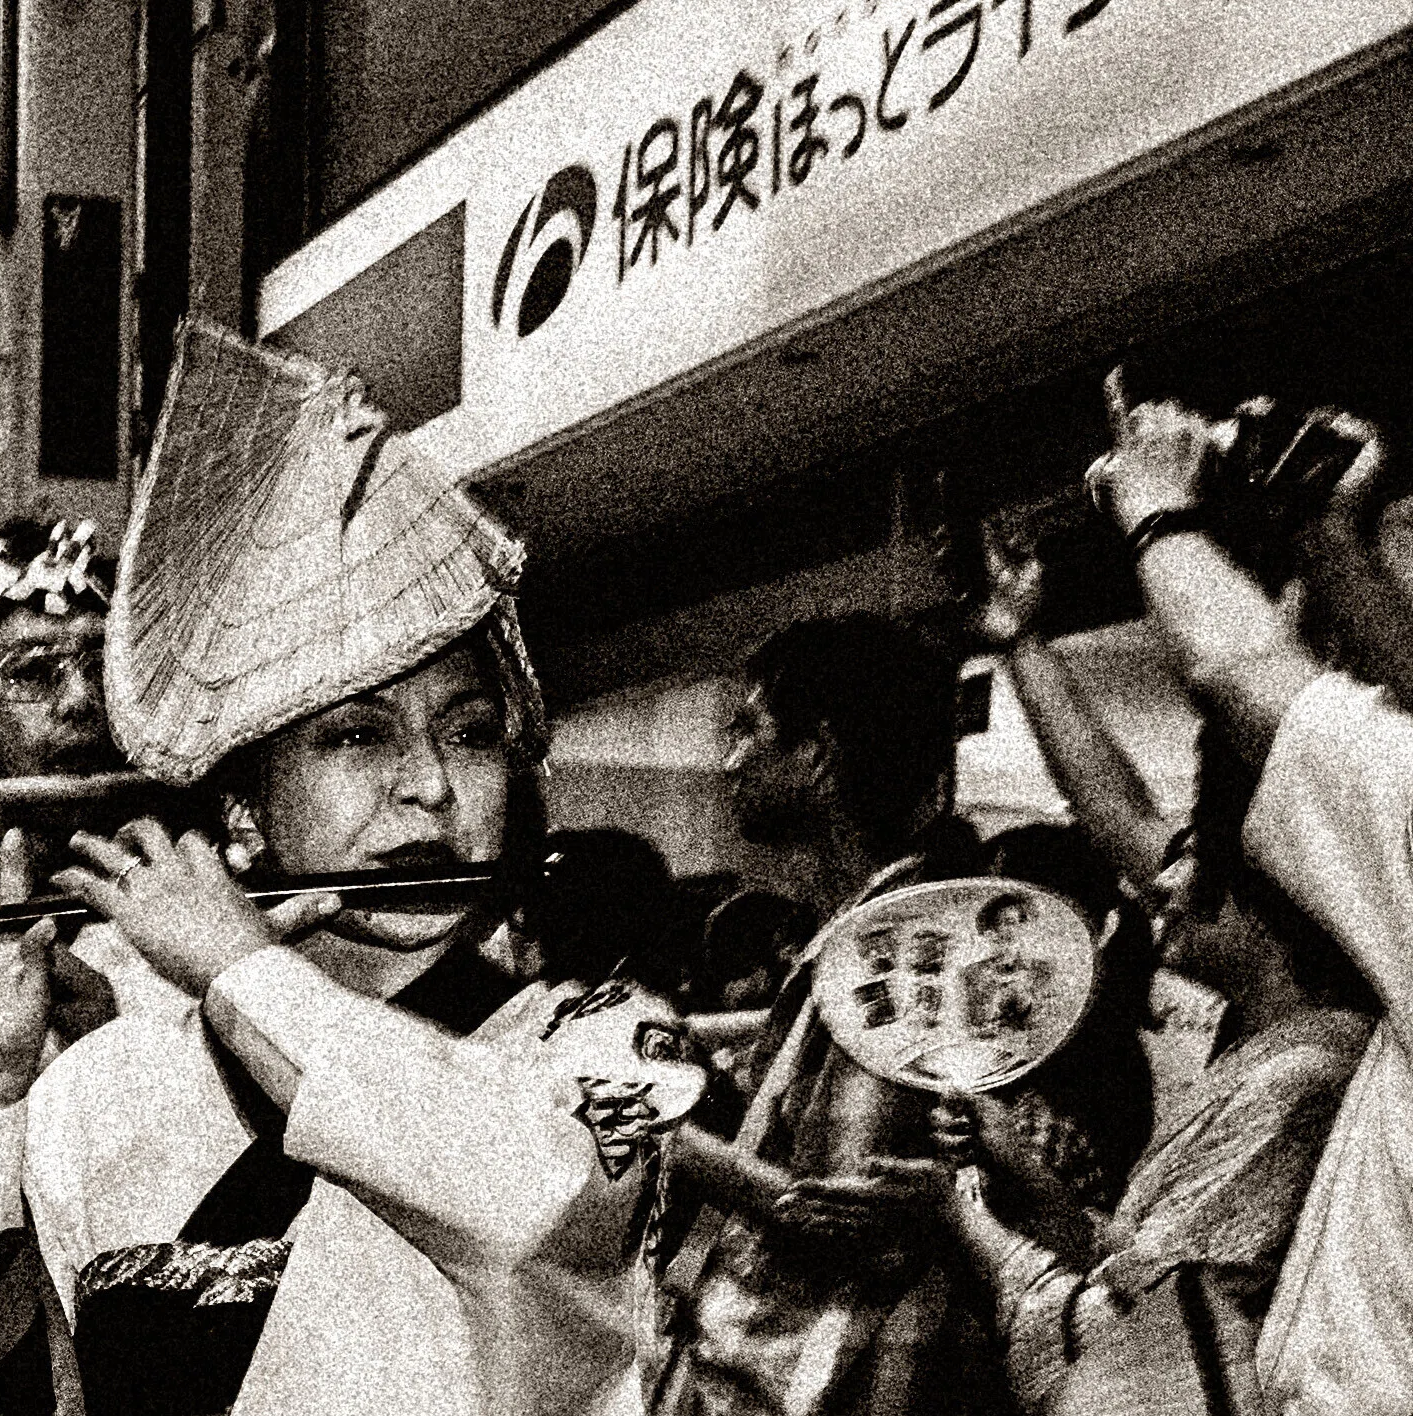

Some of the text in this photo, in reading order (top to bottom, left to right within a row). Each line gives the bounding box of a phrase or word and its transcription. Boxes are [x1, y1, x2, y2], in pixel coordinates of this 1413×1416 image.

[612, 0, 1115, 285] 保険ほっとライ
